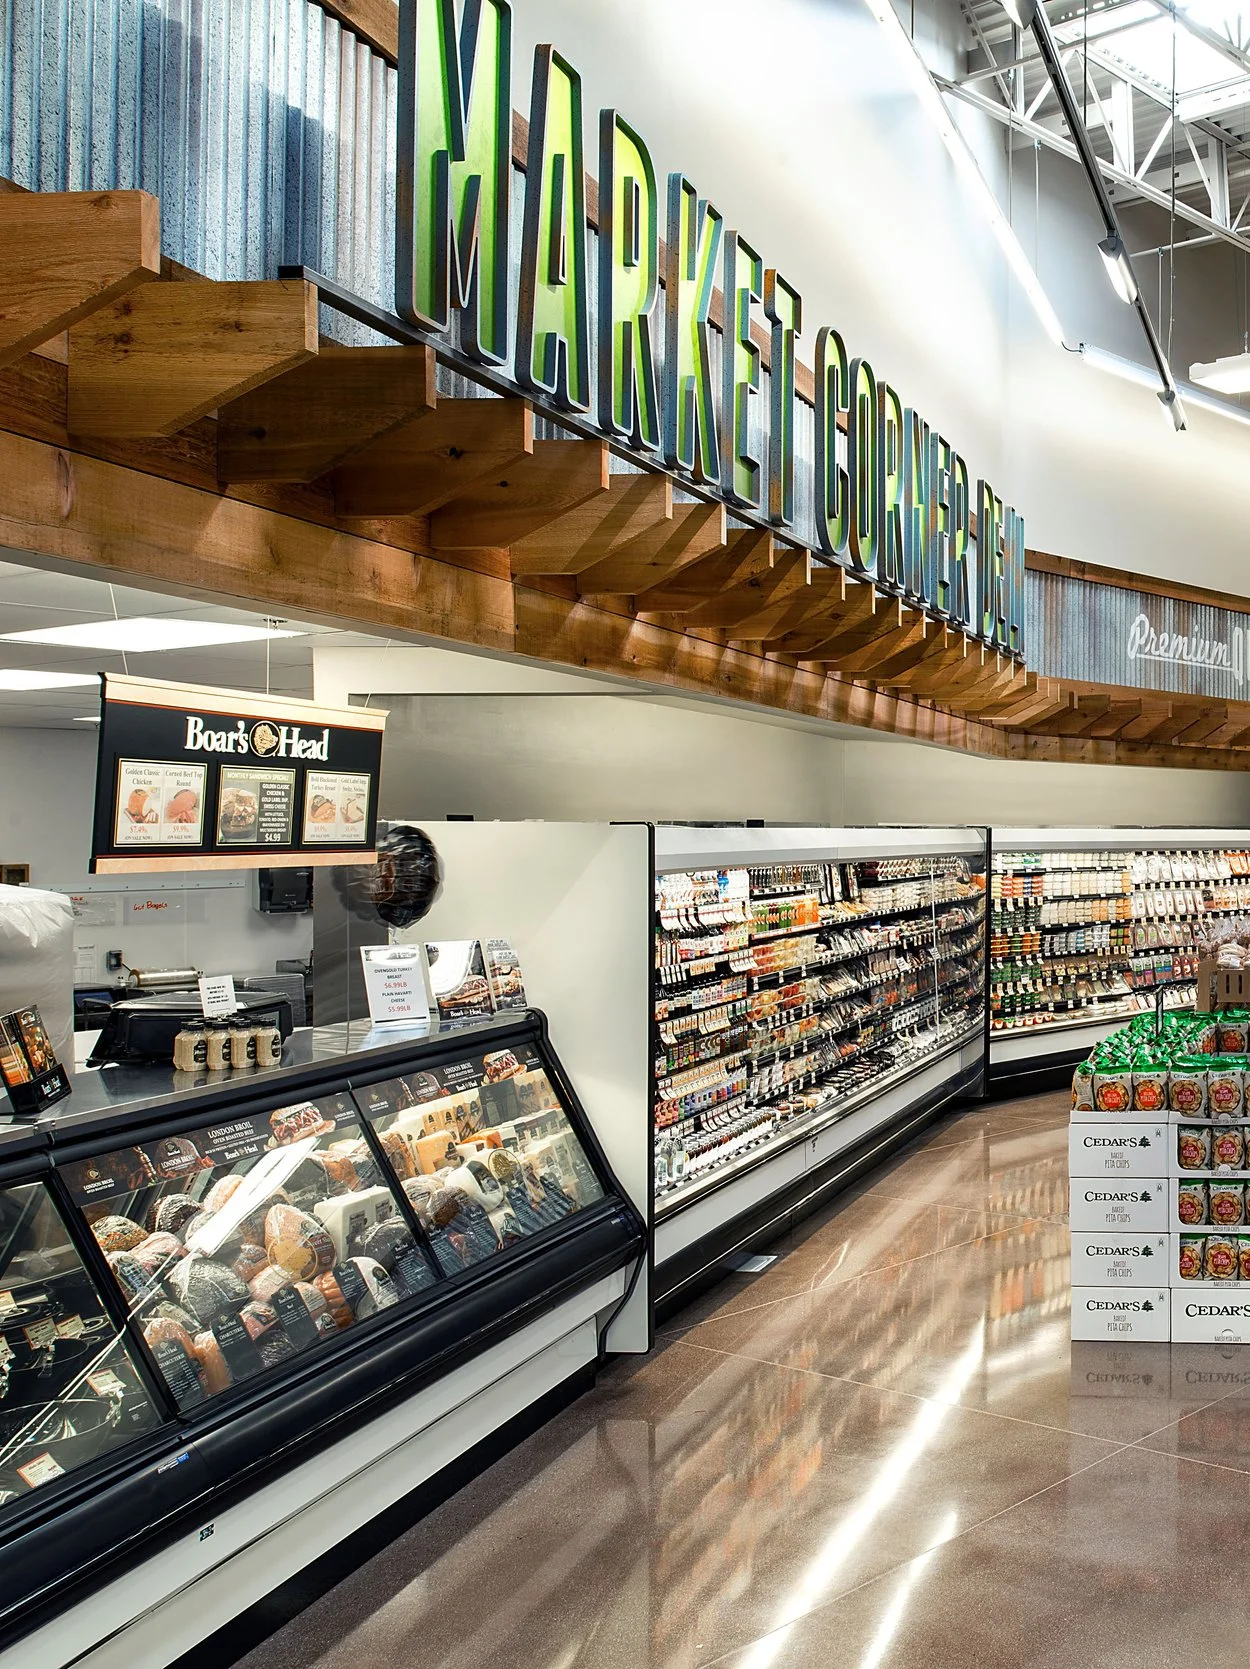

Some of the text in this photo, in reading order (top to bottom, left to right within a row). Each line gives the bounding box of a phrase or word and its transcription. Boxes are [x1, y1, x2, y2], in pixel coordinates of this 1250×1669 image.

[395, 0, 802, 526] MARKET
[814, 326, 971, 627] CORNER
[1127, 613, 1232, 669] Premium
[184, 716, 330, 761] Boar's Head
[125, 768, 143, 776] Golden
[194, 771, 203, 779] Top
[265, 833, 281, 842] $4.99
[384, 981, 407, 989] $6.99LB
[470, 1008, 482, 1016] Head
[207, 1121, 253, 1139] LONDON BROIL
[212, 1136, 228, 1144] OVEN
[228, 1132, 244, 1141] ROASTED
[1083, 1136, 1137, 1148] CEDAR'S
[224, 1149, 240, 1160] Boar's
[245, 1144, 259, 1155] Head
[1104, 1160, 1130, 1168] PITA CHIPS
[1084, 1191, 1138, 1202] CEDAR'S
[1105, 1214, 1131, 1222] PITA CHIPS
[1085, 1245, 1140, 1257] CEDAR'S
[1107, 1268, 1132, 1277] PITA CHIPS
[1086, 1300, 1140, 1311] CEDAR'S
[1107, 1323, 1132, 1331] PITA CHIPS
[219, 1325, 244, 1341] CHARCUTERIE
[158, 1353, 185, 1369] CHARCUTERIE
